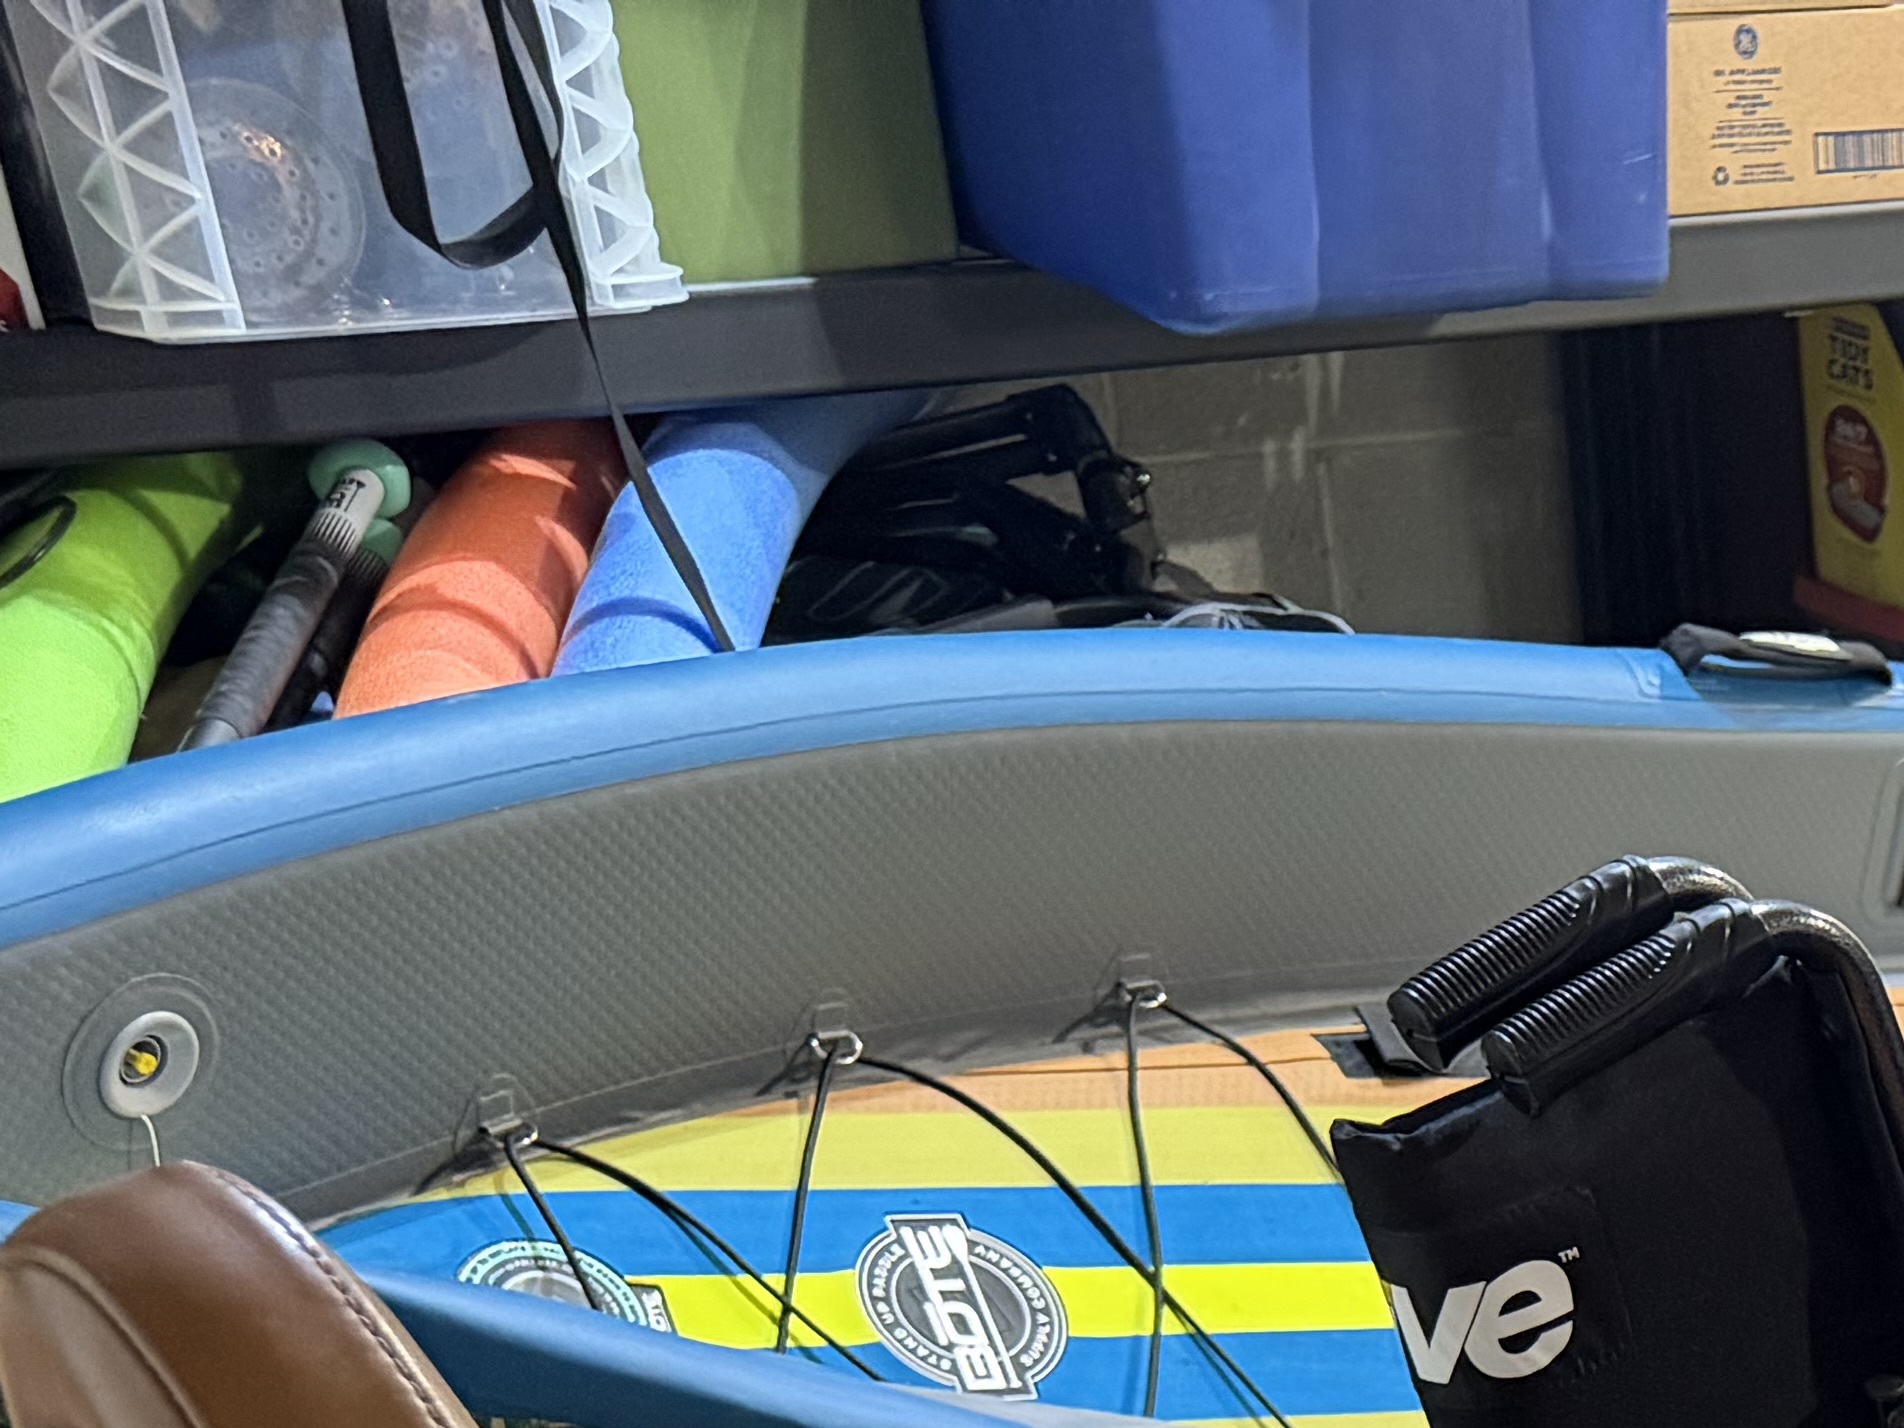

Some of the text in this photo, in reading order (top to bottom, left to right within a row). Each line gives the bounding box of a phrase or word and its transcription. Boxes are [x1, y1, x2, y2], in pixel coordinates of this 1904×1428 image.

[871, 1242, 953, 1372] STAND UP PADDLE
[973, 1243, 1047, 1310] COMPANY
